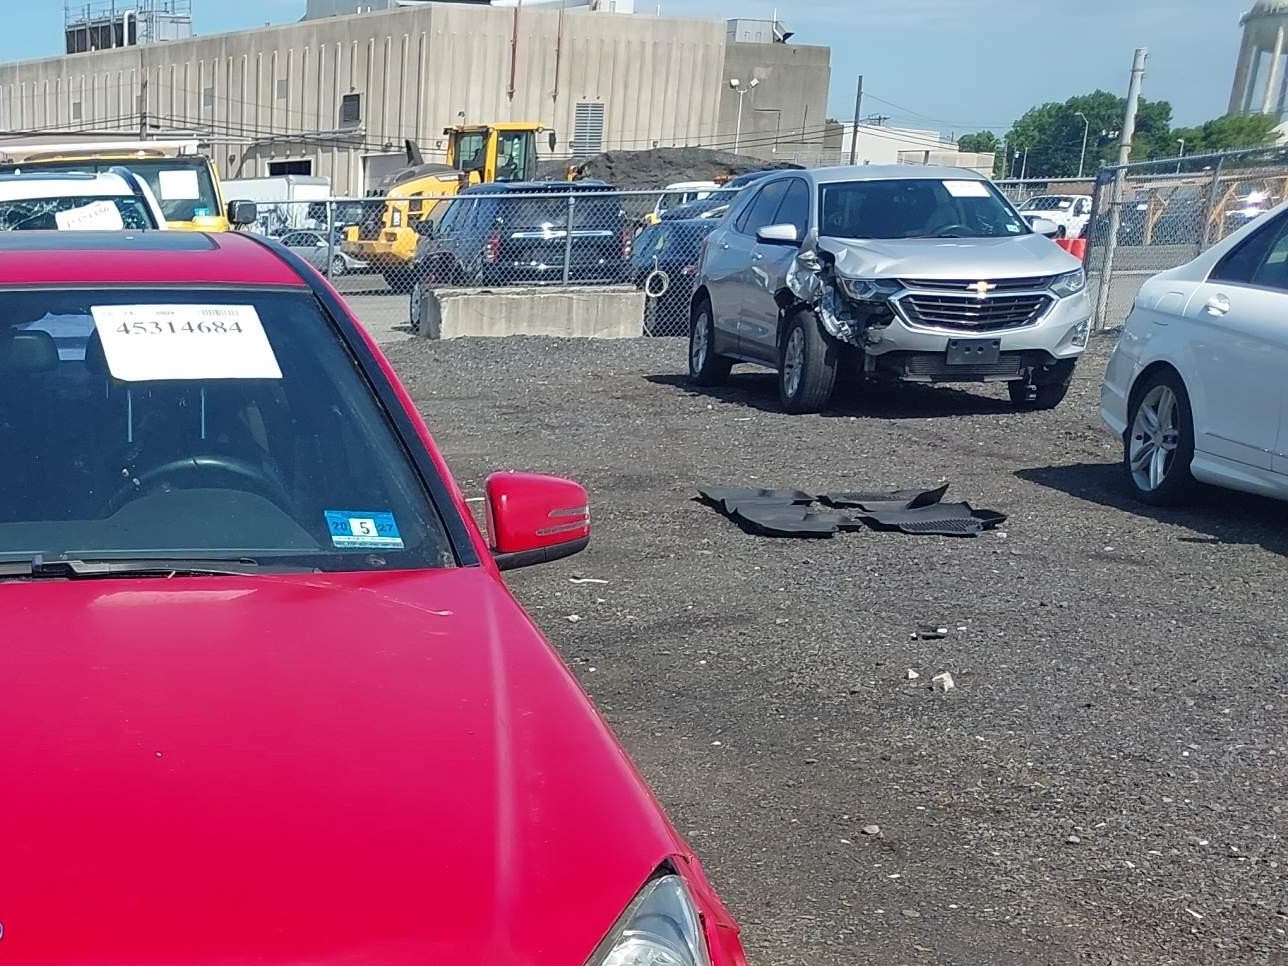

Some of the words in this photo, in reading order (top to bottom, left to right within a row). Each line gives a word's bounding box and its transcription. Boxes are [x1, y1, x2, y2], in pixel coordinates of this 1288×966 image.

[116, 321, 243, 335] 45314684
[332, 521, 347, 532] 20
[359, 521, 370, 535] 5
[378, 523, 393, 533] 27
